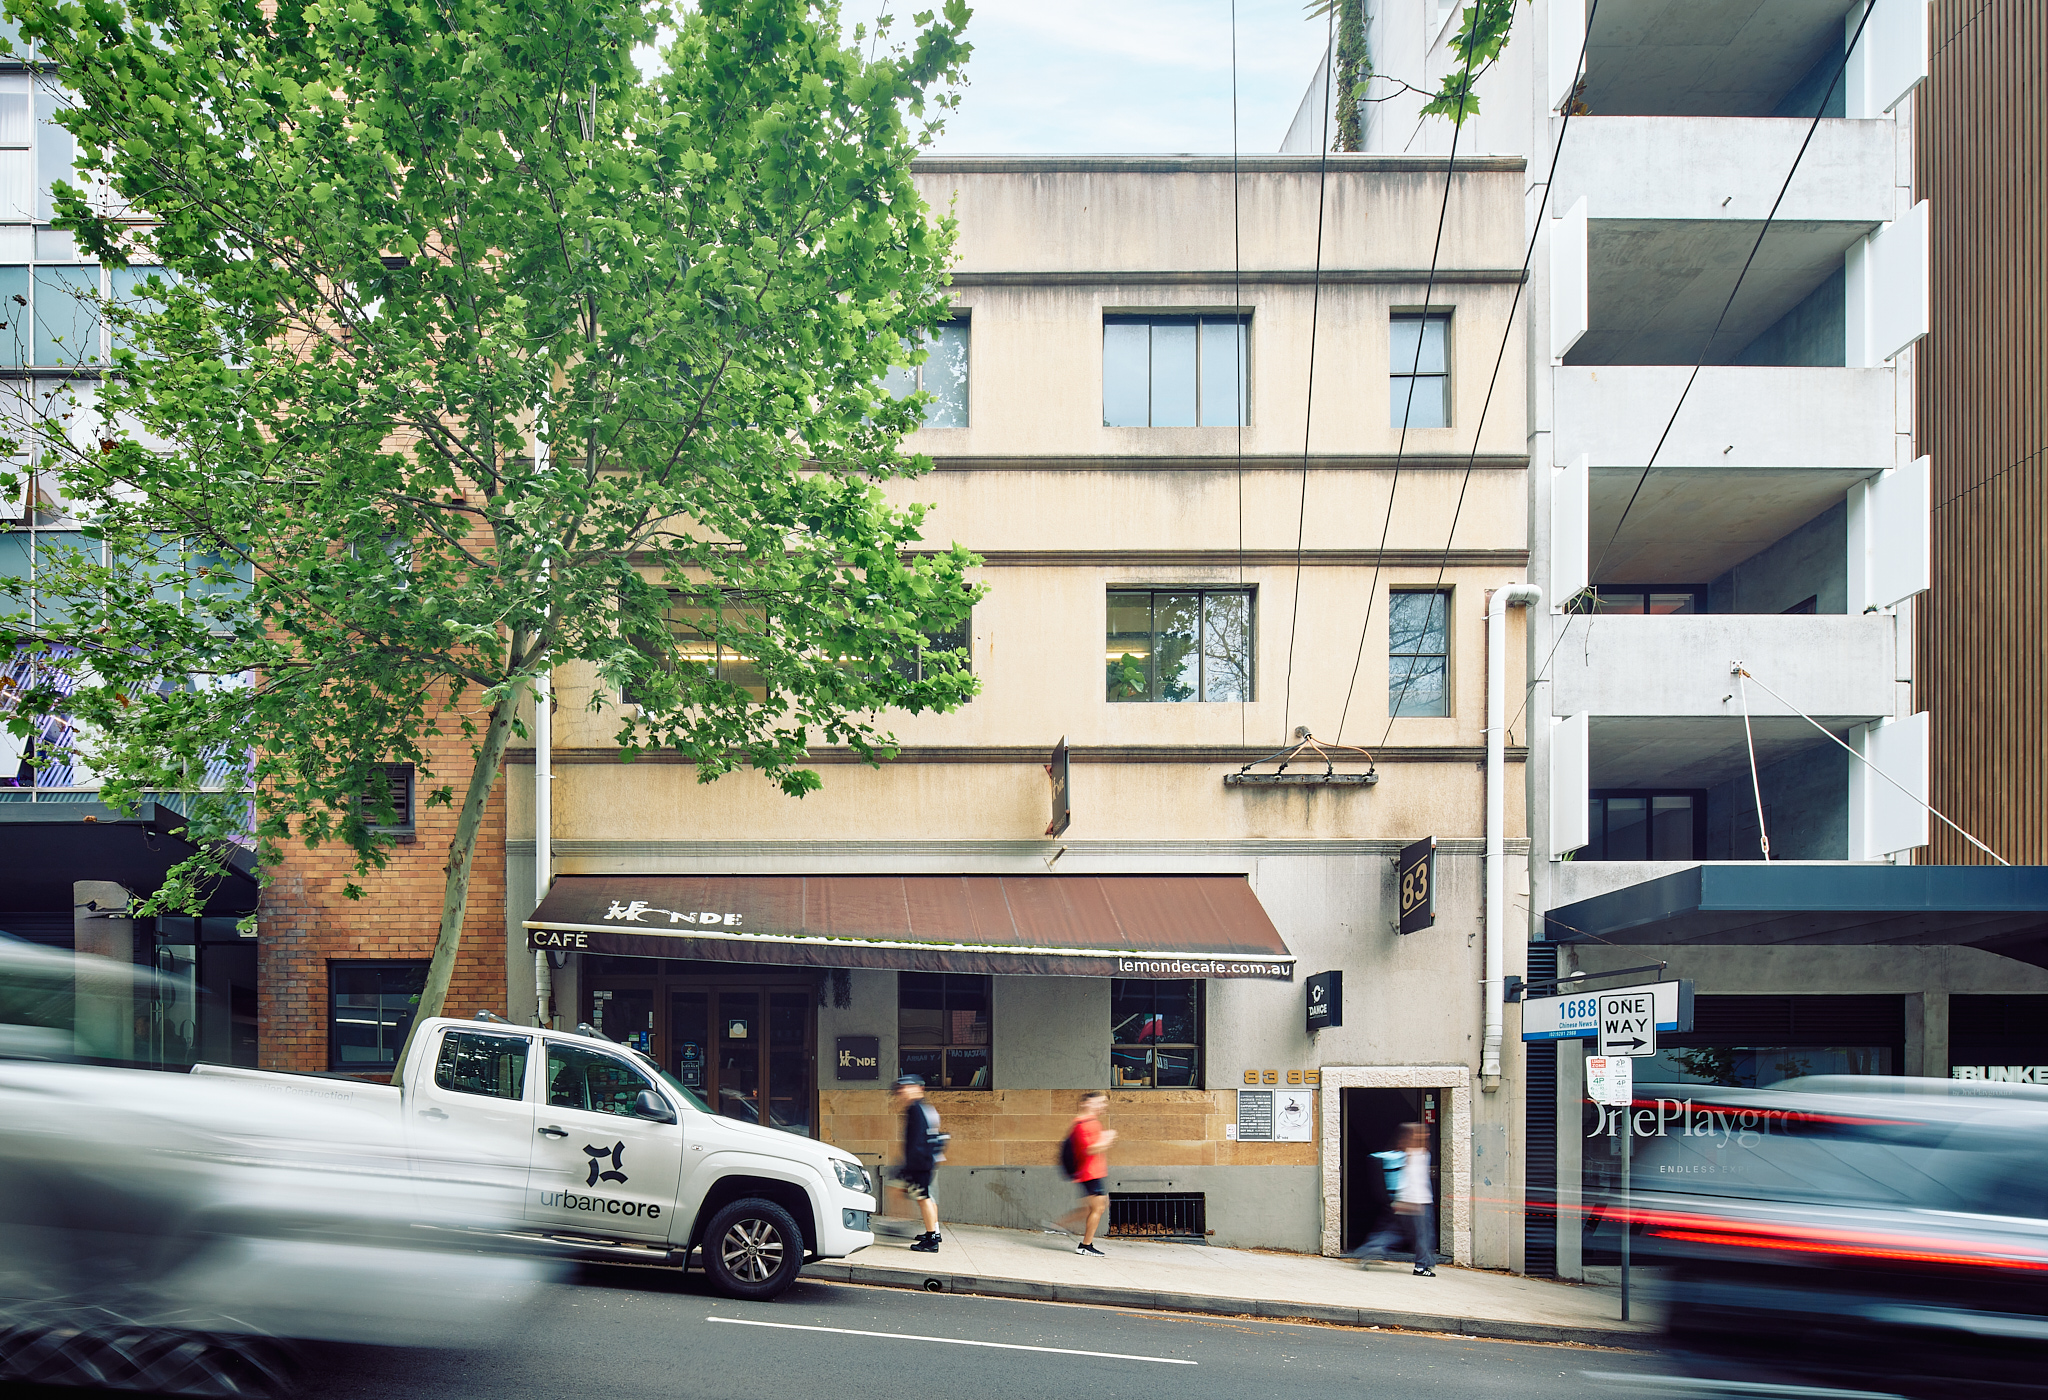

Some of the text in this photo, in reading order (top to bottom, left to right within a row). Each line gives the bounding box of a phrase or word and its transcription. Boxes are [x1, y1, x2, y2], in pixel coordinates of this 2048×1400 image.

[1402, 862, 1428, 911] 83
[533, 931, 588, 949] CAFÉ
[1118, 957, 1291, 977] lemondecafe.com.au
[1308, 1003, 1328, 1016] DANCE
[1559, 999, 1596, 1019] 1688
[1608, 999, 1646, 1014] ONE
[1605, 1018, 1648, 1034] WAY
[839, 1050, 851, 1059] LE
[1244, 1070, 1320, 1084] 83 85
[1660, 1165, 1716, 1174] ENDLESS
[540, 1189, 661, 1219] urbancore
